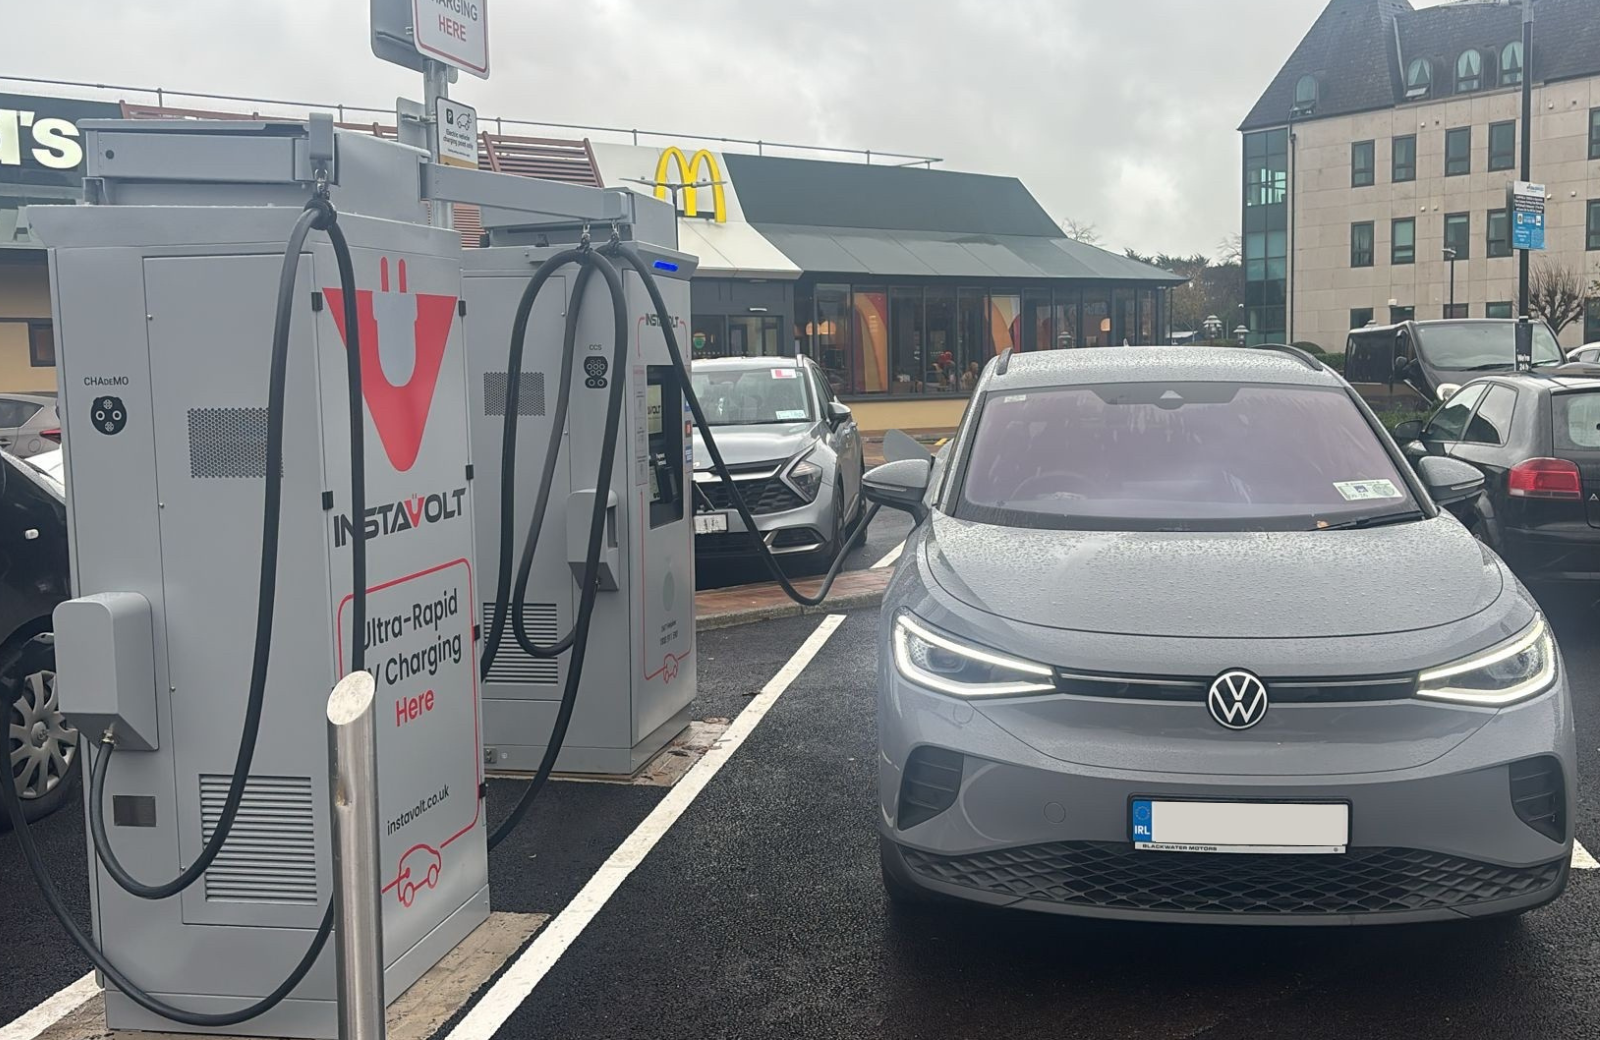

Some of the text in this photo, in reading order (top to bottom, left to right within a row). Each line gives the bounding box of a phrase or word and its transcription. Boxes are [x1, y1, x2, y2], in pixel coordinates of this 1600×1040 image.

[432, 0, 478, 22] RGING
[438, 14, 467, 42] HERE
[333, 487, 466, 548] INSTAVOLT
[385, 633, 462, 685] Charging
[396, 689, 434, 727] Here
[387, 784, 450, 836] instavolt.co.uk
[1134, 825, 1151, 835] IRL
